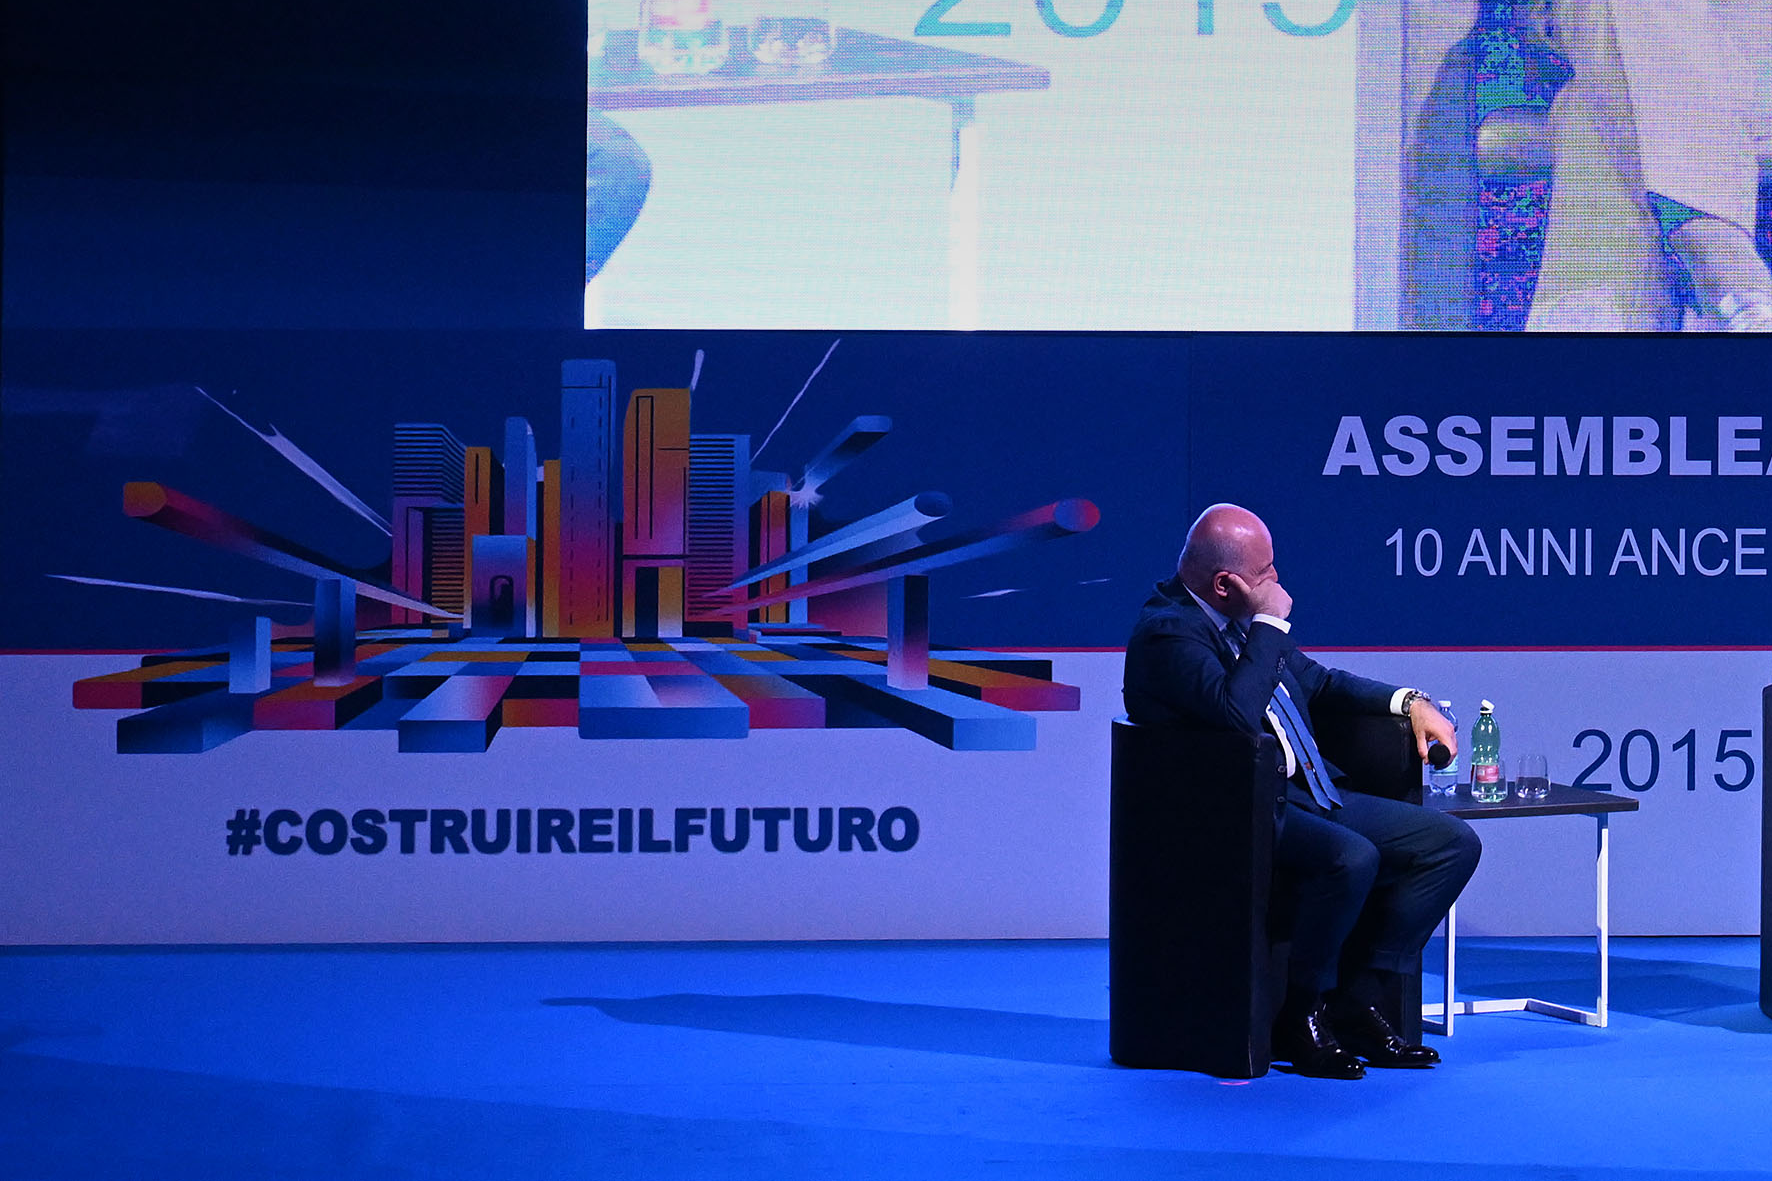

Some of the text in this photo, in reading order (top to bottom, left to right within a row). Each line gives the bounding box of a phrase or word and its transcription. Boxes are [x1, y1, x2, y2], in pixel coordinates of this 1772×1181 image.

[1385, 528, 1443, 577] 10
[1458, 528, 1592, 576] ANNI
[1609, 527, 1768, 577] ANCE
[1572, 729, 1755, 792] 2015
[226, 807, 920, 856] #COSTRUIREILFUTURO
